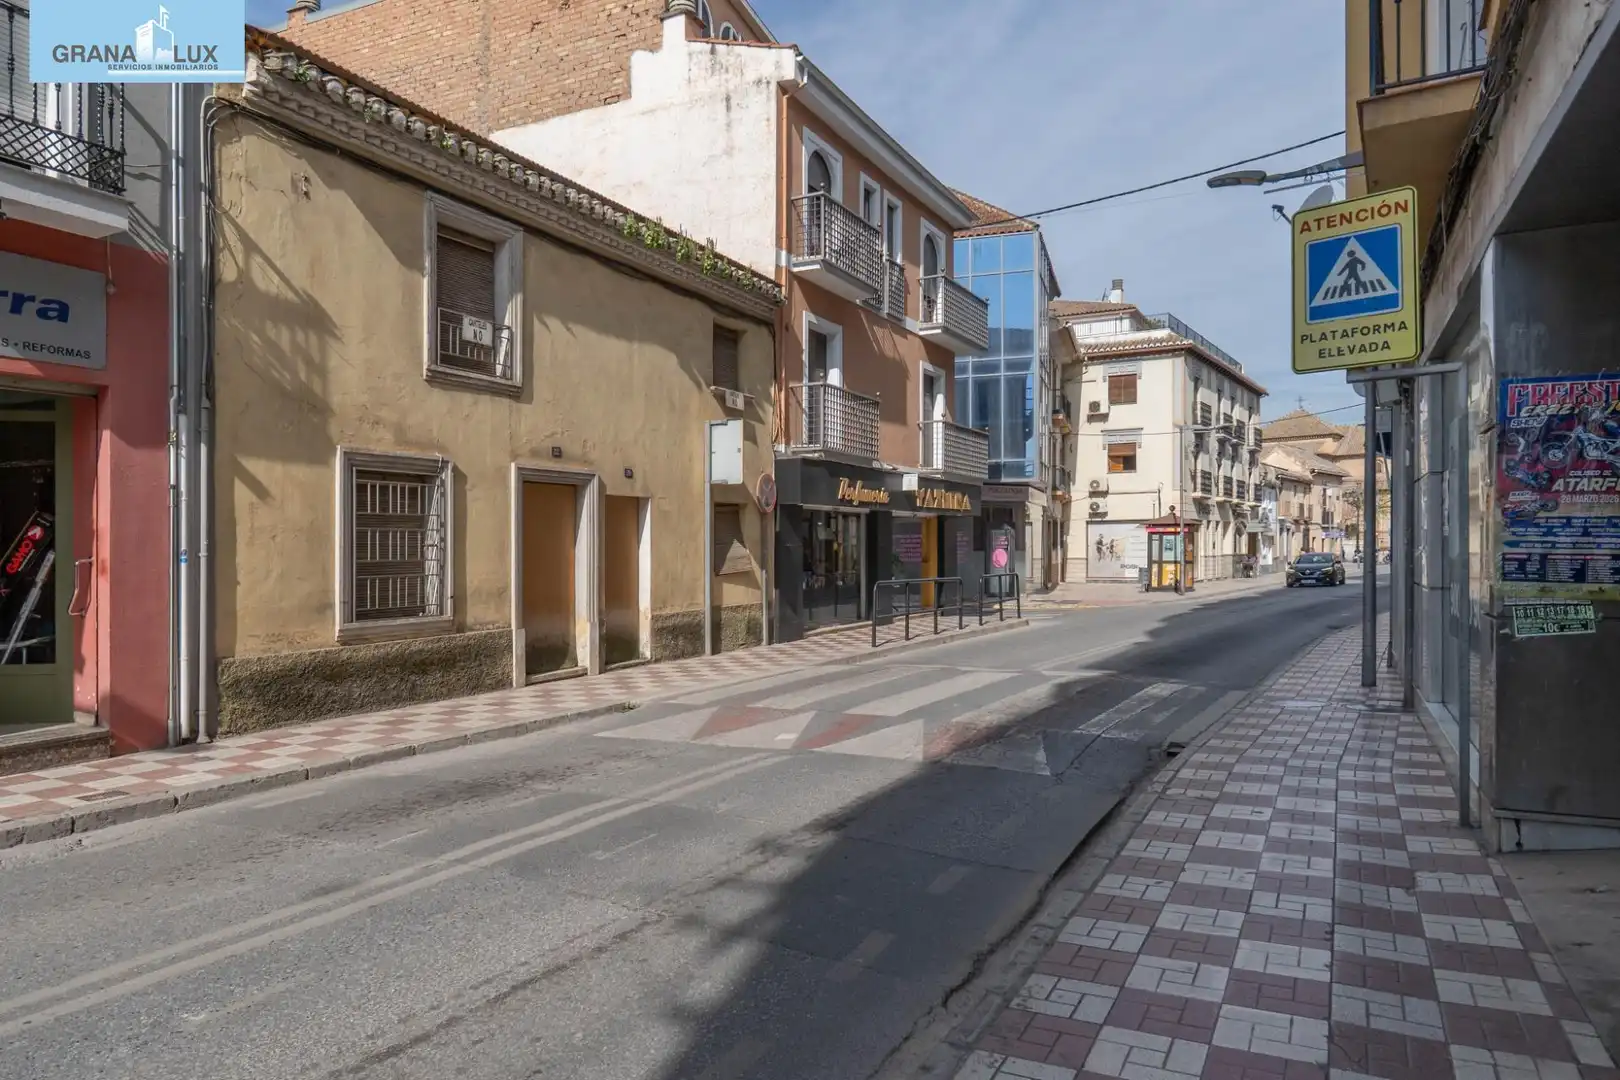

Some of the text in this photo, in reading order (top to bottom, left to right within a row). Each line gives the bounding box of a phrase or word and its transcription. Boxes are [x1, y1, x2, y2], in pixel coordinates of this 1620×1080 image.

[1300, 200, 1408, 234] ATENCIÓN
[1300, 321, 1408, 344] PLATAFORMA
[22, 341, 91, 359] REFORMAS
[1318, 340, 1391, 359] ELEVADA
